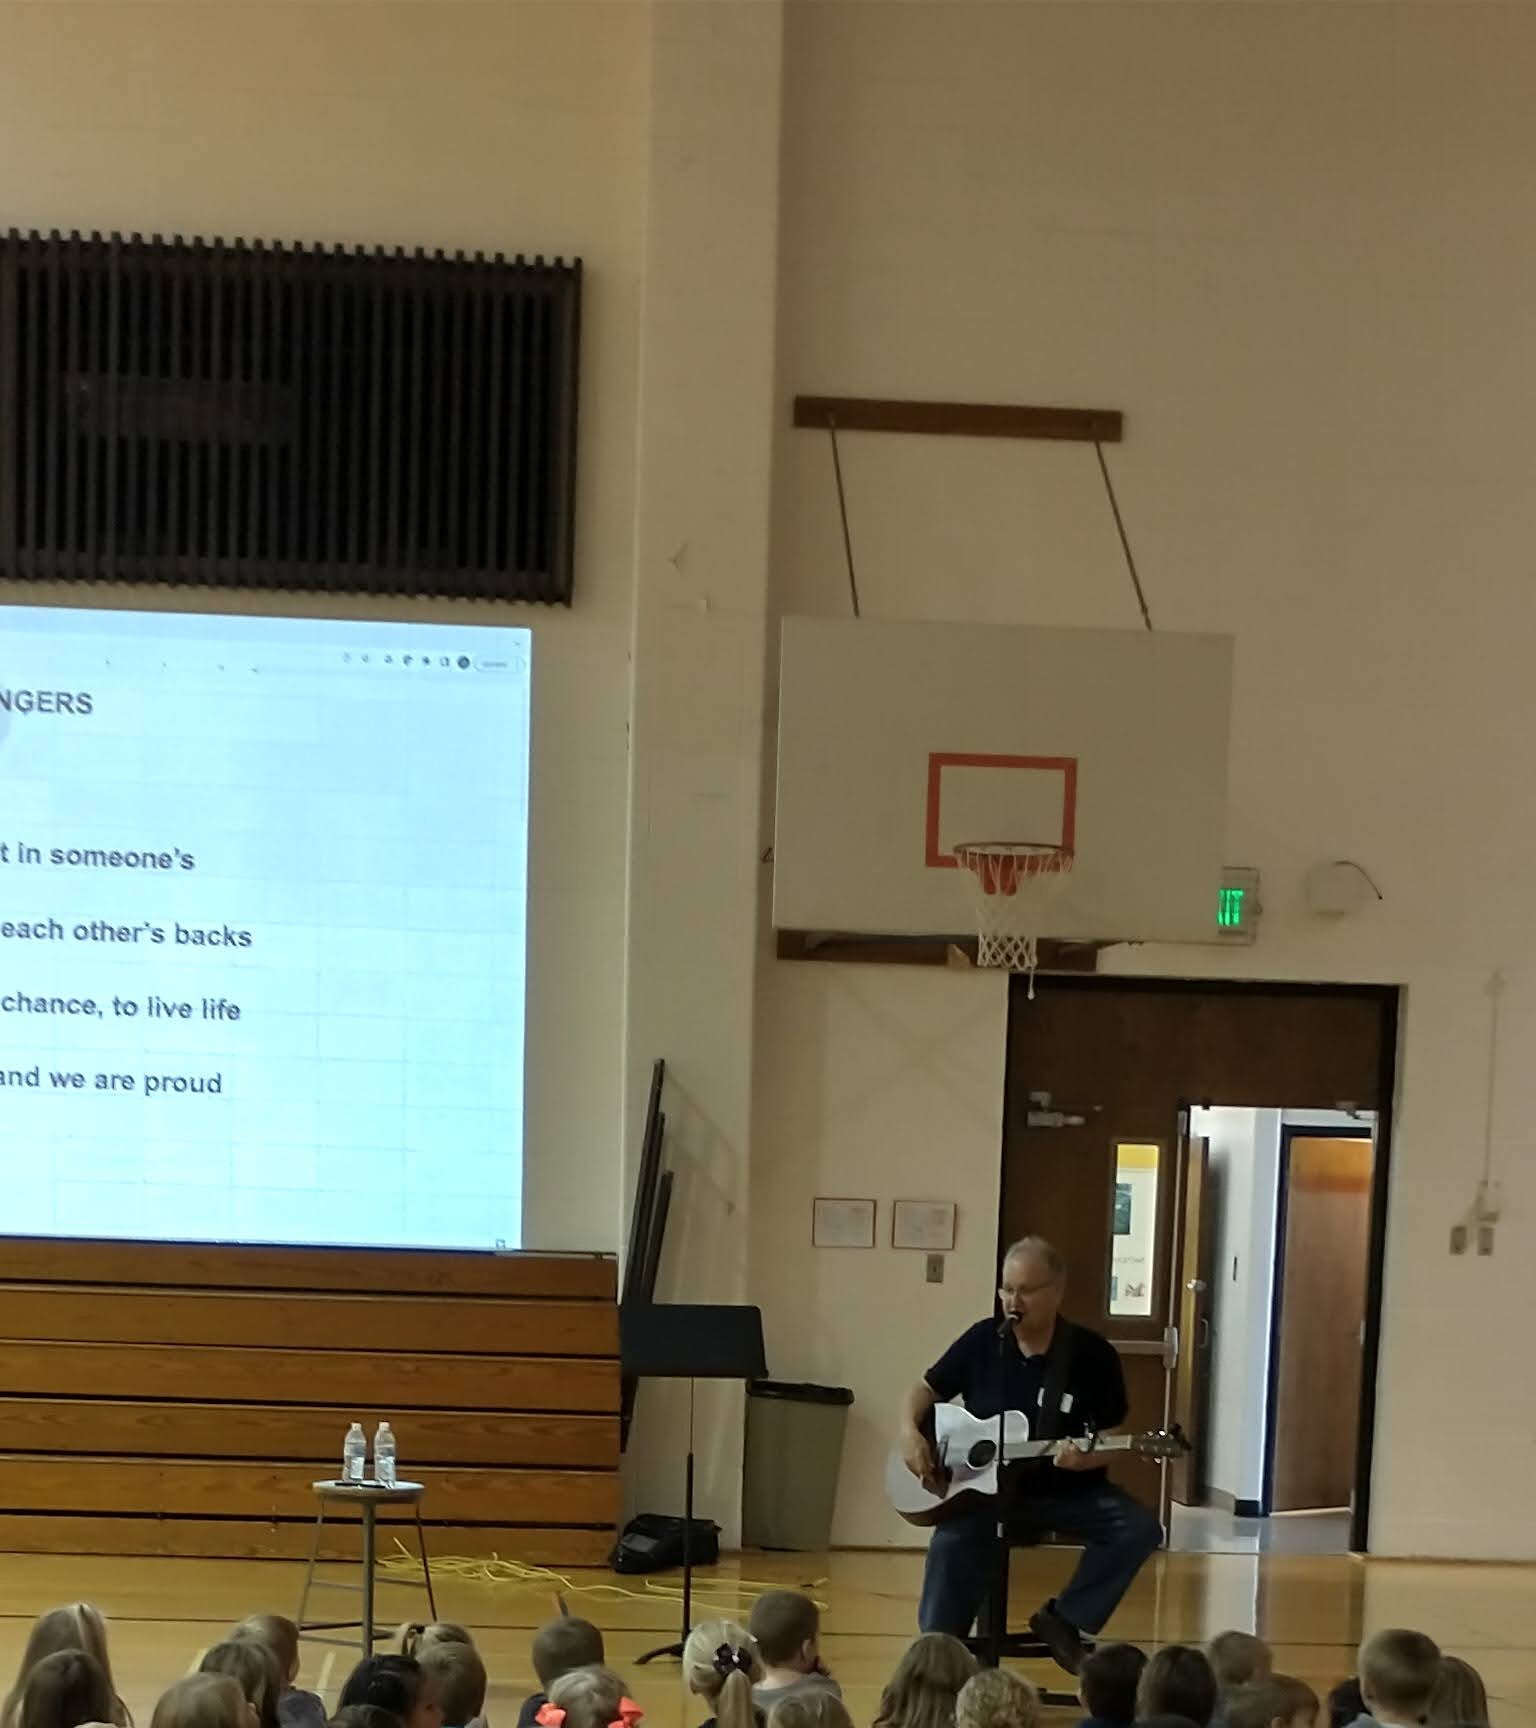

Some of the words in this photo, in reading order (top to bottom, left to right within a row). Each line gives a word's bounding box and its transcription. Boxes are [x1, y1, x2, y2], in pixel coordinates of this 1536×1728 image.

[17, 841, 42, 865] in
[49, 847, 196, 871] someone's
[0, 917, 64, 941] each
[72, 919, 166, 945] other's
[174, 921, 253, 948] backs
[0, 991, 103, 1019] chance,
[111, 995, 139, 1017] to
[147, 995, 193, 1019] live
[201, 997, 241, 1021] life
[48, 1071, 87, 1089] we
[94, 1073, 136, 1091] are
[143, 1072, 222, 1097] proud
